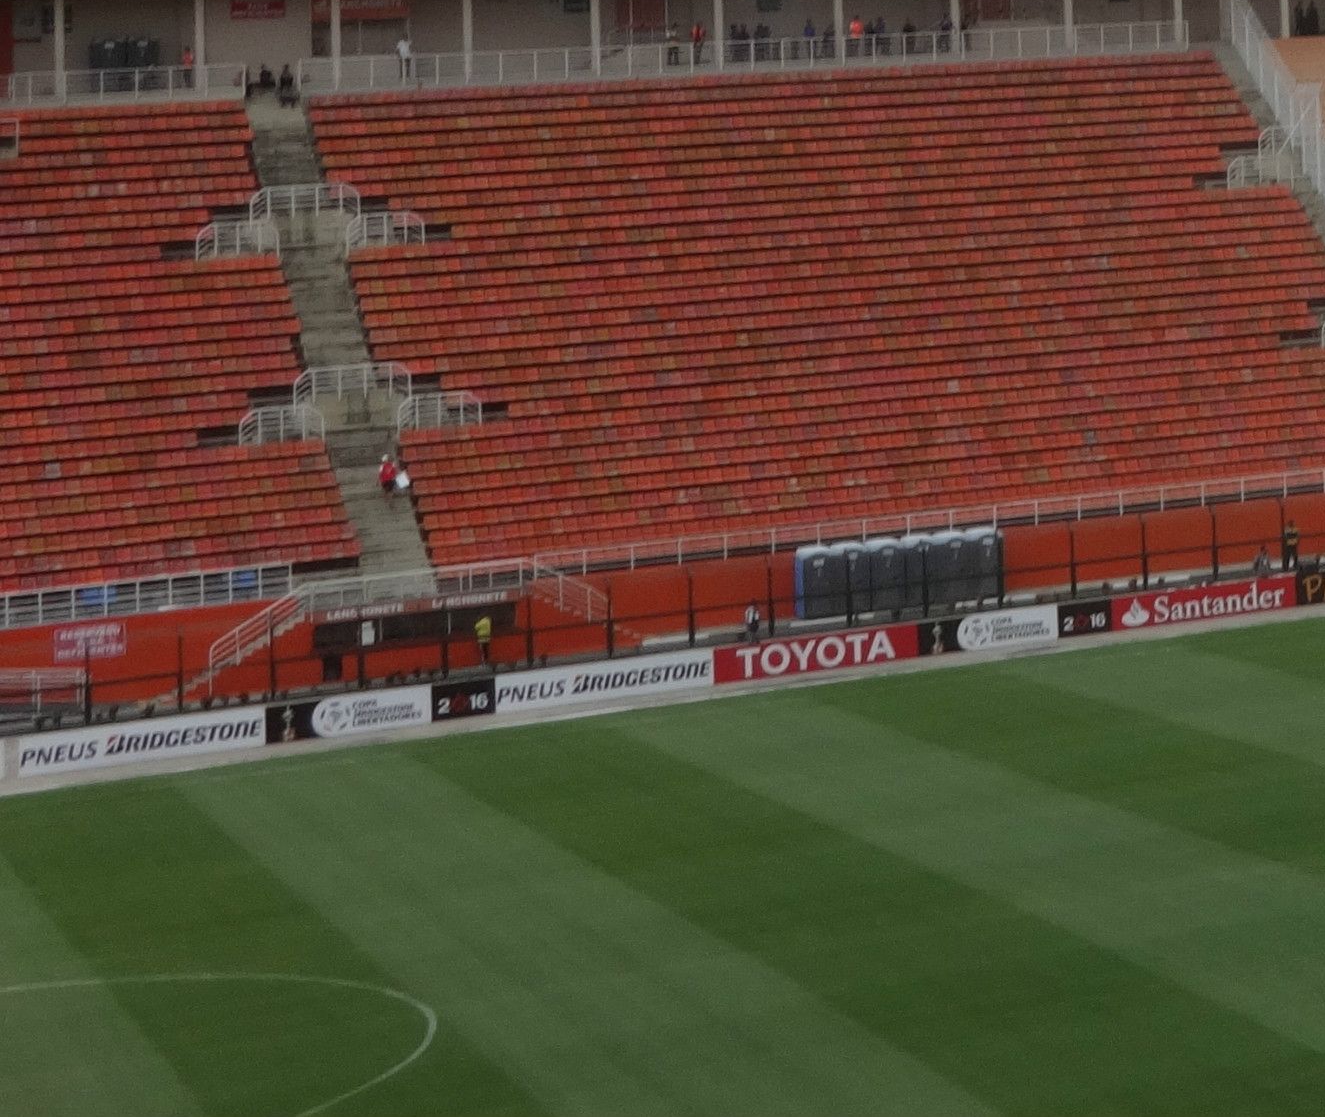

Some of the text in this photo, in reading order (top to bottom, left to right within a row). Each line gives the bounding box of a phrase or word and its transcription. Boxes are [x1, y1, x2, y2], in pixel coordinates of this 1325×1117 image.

[1153, 581, 1285, 624] Santander
[736, 628, 896, 679] TOYOTA
[497, 659, 712, 704] PNEUS BRIDGESTONE
[20, 719, 262, 767] PNEUS BRIDGESTONE
